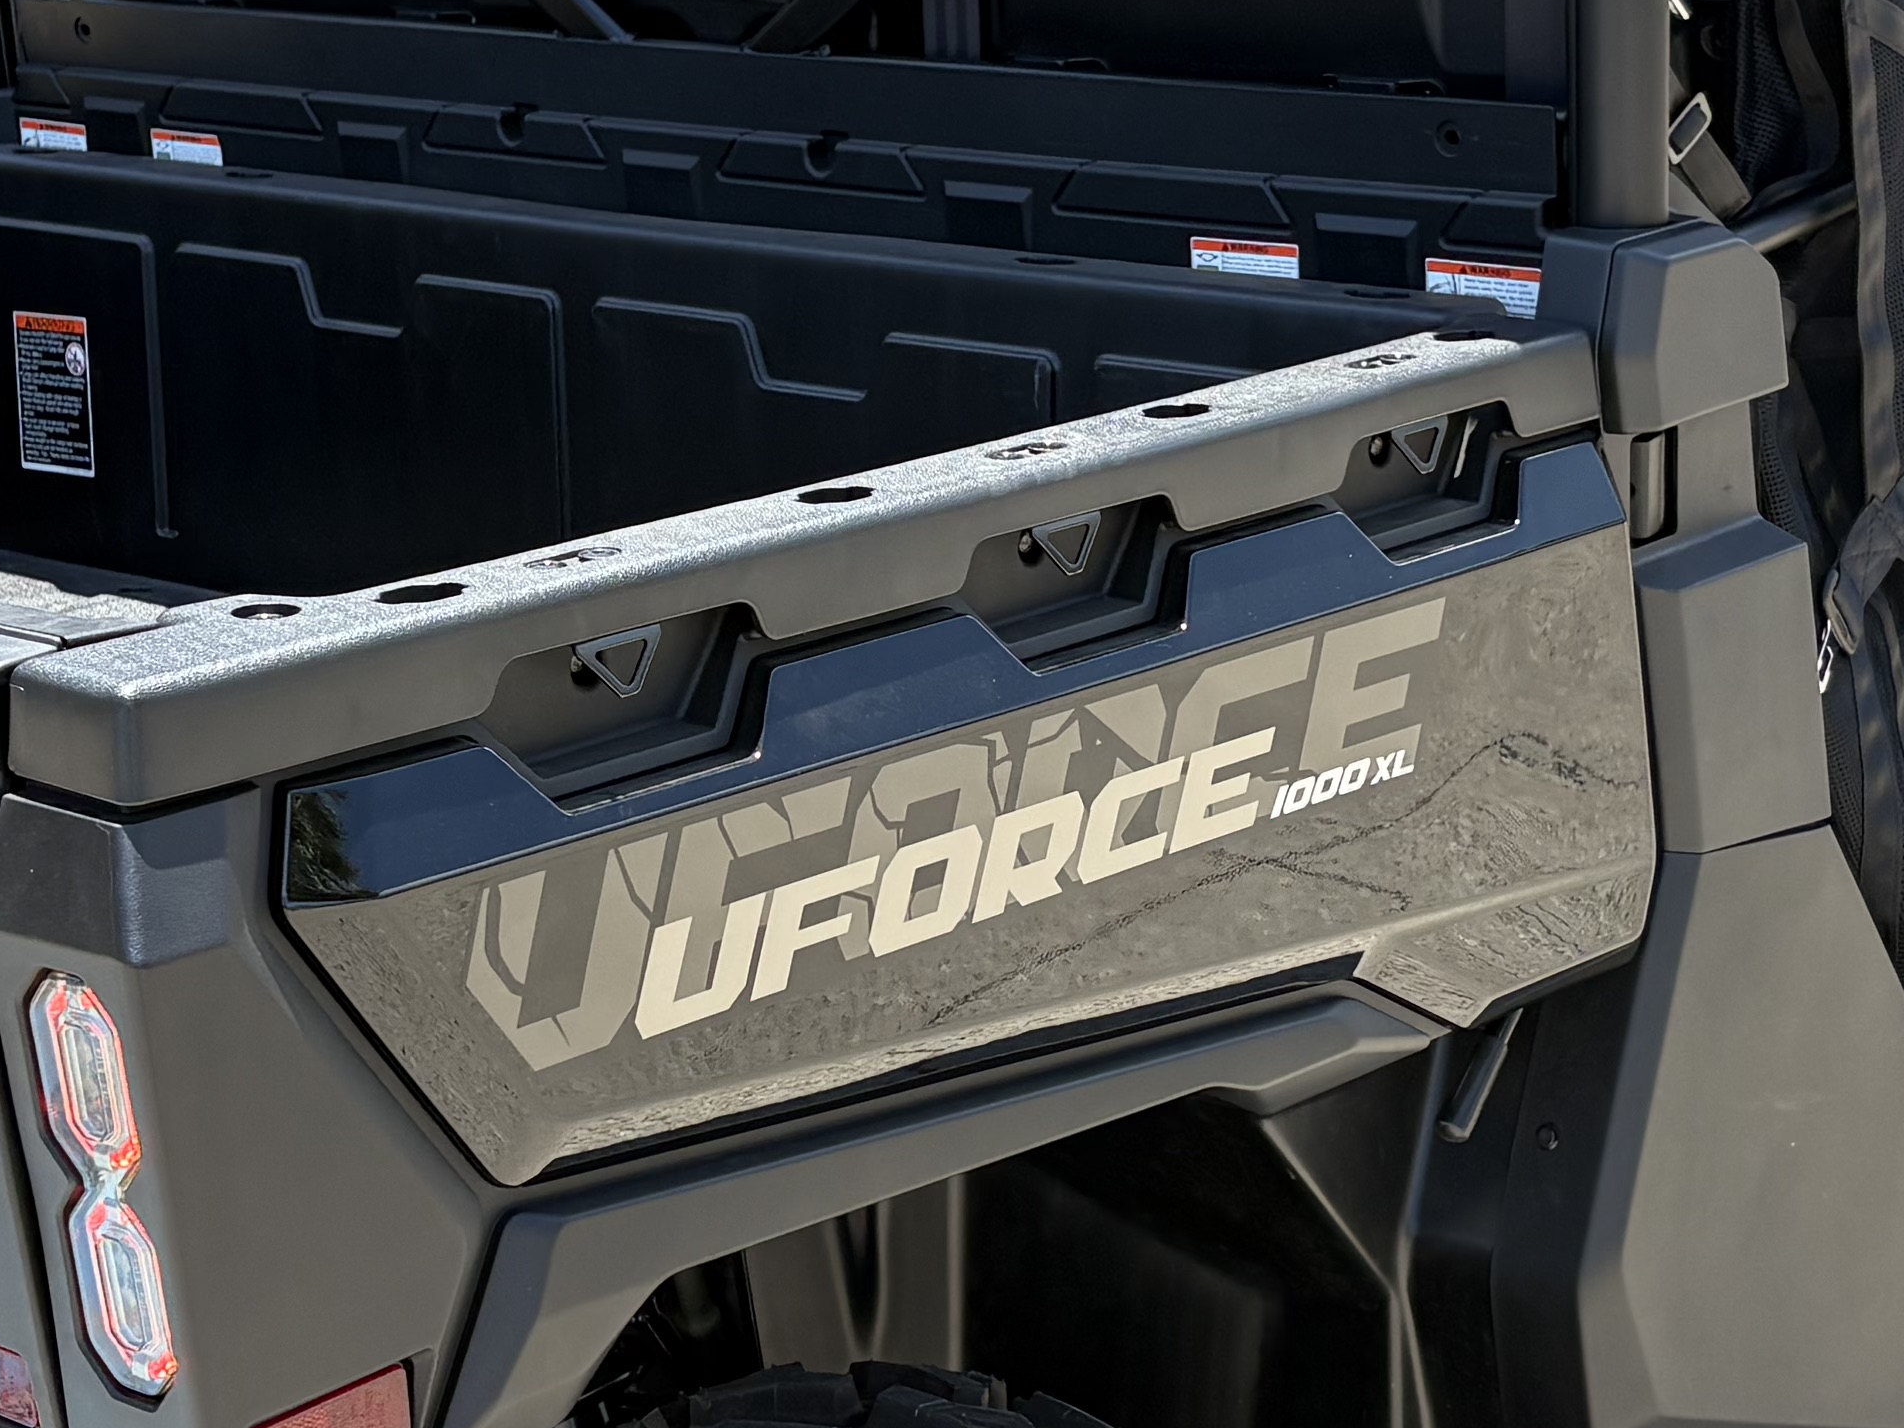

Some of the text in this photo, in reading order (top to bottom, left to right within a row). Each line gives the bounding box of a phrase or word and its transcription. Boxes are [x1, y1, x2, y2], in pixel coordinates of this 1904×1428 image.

[634, 726, 1415, 1040] UFORCE 1000 XL
